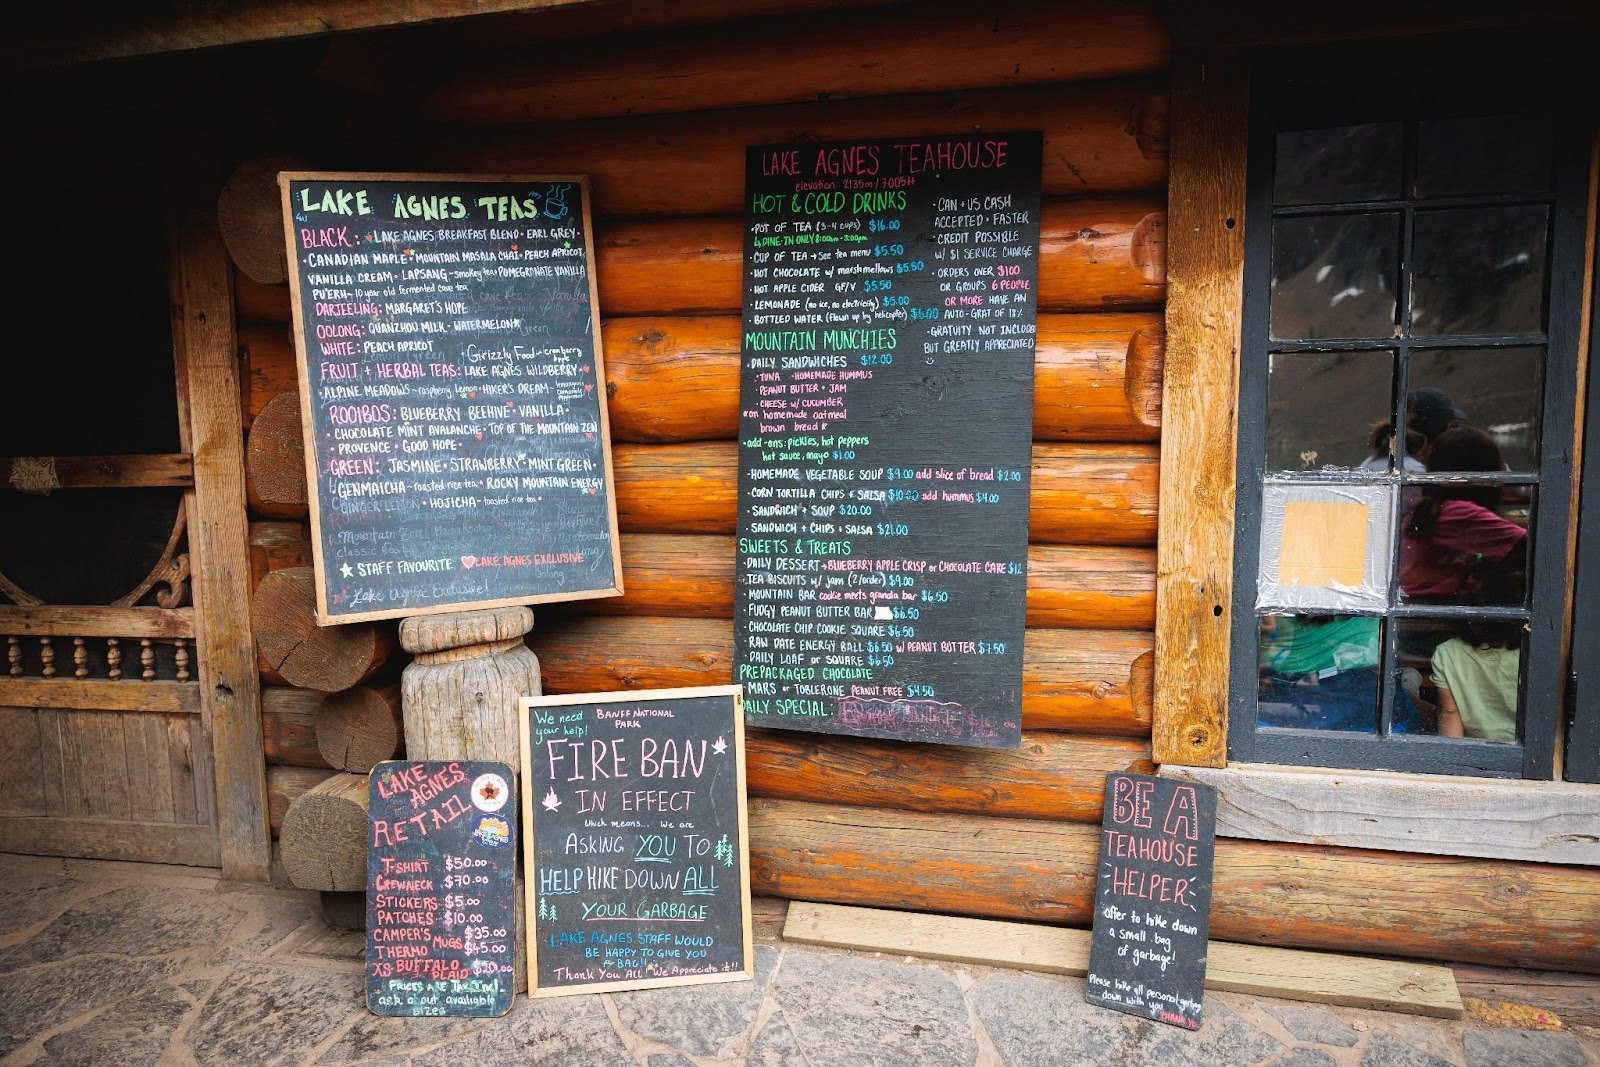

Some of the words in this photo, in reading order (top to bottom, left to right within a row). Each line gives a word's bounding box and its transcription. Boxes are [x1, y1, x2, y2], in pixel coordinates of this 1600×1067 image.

[762, 151, 800, 176] LAKE
[815, 147, 880, 176] AGNES
[893, 141, 1008, 174] TEAHOUSE
[301, 188, 370, 216] LAKE
[394, 193, 466, 221] AGNES
[479, 195, 538, 221] TEAS
[754, 195, 787, 213] HOT
[805, 192, 845, 214] COLD
[853, 190, 907, 214] DRINKS
[754, 223, 771, 233] POT
[774, 222, 787, 232] OF
[793, 222, 812, 232] TEA
[869, 220, 900, 233] $16.00
[934, 215, 982, 228] ACCEPTED
[993, 211, 1029, 225] FASTER
[374, 230, 399, 242] LAKE
[403, 230, 434, 242] AGNES
[438, 229, 486, 241] BREAKFAST
[490, 229, 519, 240] BLEND
[526, 229, 547, 239] EARL
[551, 228, 575, 239] GREY
[938, 232, 970, 245] CREDIT
[975, 231, 1020, 243] POSSIBLE
[308, 252, 368, 267] CANADIAN
[372, 253, 408, 265] MAPLE
[415, 252, 460, 264] MOUNTAIN
[462, 252, 496, 262] MASALA
[498, 251, 520, 261] CHAI
[524, 249, 550, 260] PEACH
[754, 252, 771, 263] CUP
[775, 252, 787, 262] OF
[791, 252, 808, 261] TEA
[874, 245, 903, 257] $5.50
[950, 249, 960, 259] $1
[964, 247, 997, 259] SERVICE
[1002, 246, 1032, 257] CHARGE
[385, 303, 442, 315] MARGARET'S
[445, 302, 468, 314] HOPE
[745, 332, 816, 351] MOUNTAIN
[823, 328, 896, 350] MUNCHIES
[751, 356, 775, 368] DAILY
[781, 355, 847, 368] SANDWICHES
[861, 354, 892, 365] $12.00
[401, 406, 461, 422] BLUEBERRY
[469, 406, 509, 420] BEEHIVE
[519, 404, 564, 417] VANILLA
[334, 426, 393, 440] CHOCOLATE
[398, 425, 423, 437] MINT
[429, 424, 482, 436] AVALANCHE
[489, 423, 504, 435] TOP
[507, 424, 516, 434] OF
[519, 422, 535, 433] THE
[537, 422, 580, 434] MOUNTAIN
[582, 422, 597, 433] ZEN
[338, 442, 391, 454] PROVENCE
[402, 440, 428, 452] GOOD
[432, 439, 457, 451] HOPE
[388, 458, 442, 473] JASMINE
[450, 458, 520, 471] STRAWBERRY
[528, 457, 553, 470] MINT
[557, 457, 591, 470] GREEN
[751, 469, 800, 480] HOMEMADE
[806, 469, 854, 480] VEGETABLE
[860, 469, 884, 479] SOUP
[916, 471, 932, 479] add
[935, 468, 954, 480] slice
[957, 469, 965, 480] of
[969, 469, 994, 480] bread
[997, 470, 1021, 481] $2.00
[752, 506, 798, 516] SANDWICH
[811, 506, 834, 516] SOUP
[839, 505, 871, 516] $20.00
[740, 539, 788, 553] SWEETS
[807, 541, 852, 555] TREATS
[357, 560, 393, 577] STAFF
[398, 559, 453, 573] FAVOURITE
[749, 606, 776, 617] FUDGY
[781, 606, 811, 617] PEANUT
[816, 605, 850, 617] BUTTER
[854, 607, 873, 617] BAR
[749, 637, 769, 649] RAW
[773, 638, 796, 649] DATE
[800, 640, 835, 651] ENERGY
[840, 641, 865, 651] BALL
[907, 641, 937, 653] PEANUT
[941, 642, 976, 653] BUTTER
[740, 665, 815, 680] PREPACKAGED
[823, 667, 873, 680] CHOCOLATE
[534, 710, 554, 724] We
[559, 710, 583, 722] need
[596, 708, 630, 719] BANFF
[633, 708, 674, 718] NATIONAL
[615, 720, 641, 728] PARK
[536, 726, 559, 744] your
[564, 724, 588, 736] help!
[547, 738, 628, 782] FIRE
[641, 738, 707, 778] BAN
[377, 764, 428, 799] LAKE
[410, 763, 466, 809] AGNES
[575, 790, 607, 814] IN
[622, 790, 695, 811] EFFECT
[1114, 777, 1154, 828] BE
[1164, 786, 1198, 840] A
[373, 794, 471, 848] RETAIL
[566, 832, 624, 855] ASKING
[635, 834, 676, 856] YOU
[684, 834, 710, 856] TO
[1105, 830, 1197, 867] TEAHOUSE
[445, 857, 487, 872] $50.00
[540, 868, 584, 893] HELP
[587, 866, 618, 890] HIKE
[625, 868, 680, 890] DOWN
[682, 865, 719, 890] ALL
[1113, 867, 1188, 906] HELPER
[376, 894, 438, 910] STICKERS
[445, 896, 480, 909] $5.00
[582, 902, 628, 920] YOUR
[636, 900, 708, 919] GARBAGE
[378, 911, 433, 925] PATCHES
[443, 913, 483, 925] $10.00
[1105, 906, 1126, 921] offer
[1131, 910, 1140, 923] to
[1172, 920, 1197, 935] down
[374, 929, 431, 942] CAMPER'S
[464, 926, 507, 939] $35.00
[551, 932, 586, 948] LAKE
[590, 932, 632, 944] AGNES
[638, 933, 670, 944] STAFF
[674, 935, 713, 946] WOULD
[1119, 928, 1146, 942] small
[1154, 932, 1171, 952] bag
[585, 948, 600, 957] BE
[606, 948, 636, 958] HAPPY
[640, 948, 654, 957] TO
[657, 948, 681, 958] GIVE
[686, 948, 707, 958] YOU
[1118, 946, 1129, 956] of
[1133, 949, 1176, 970] garbage!
